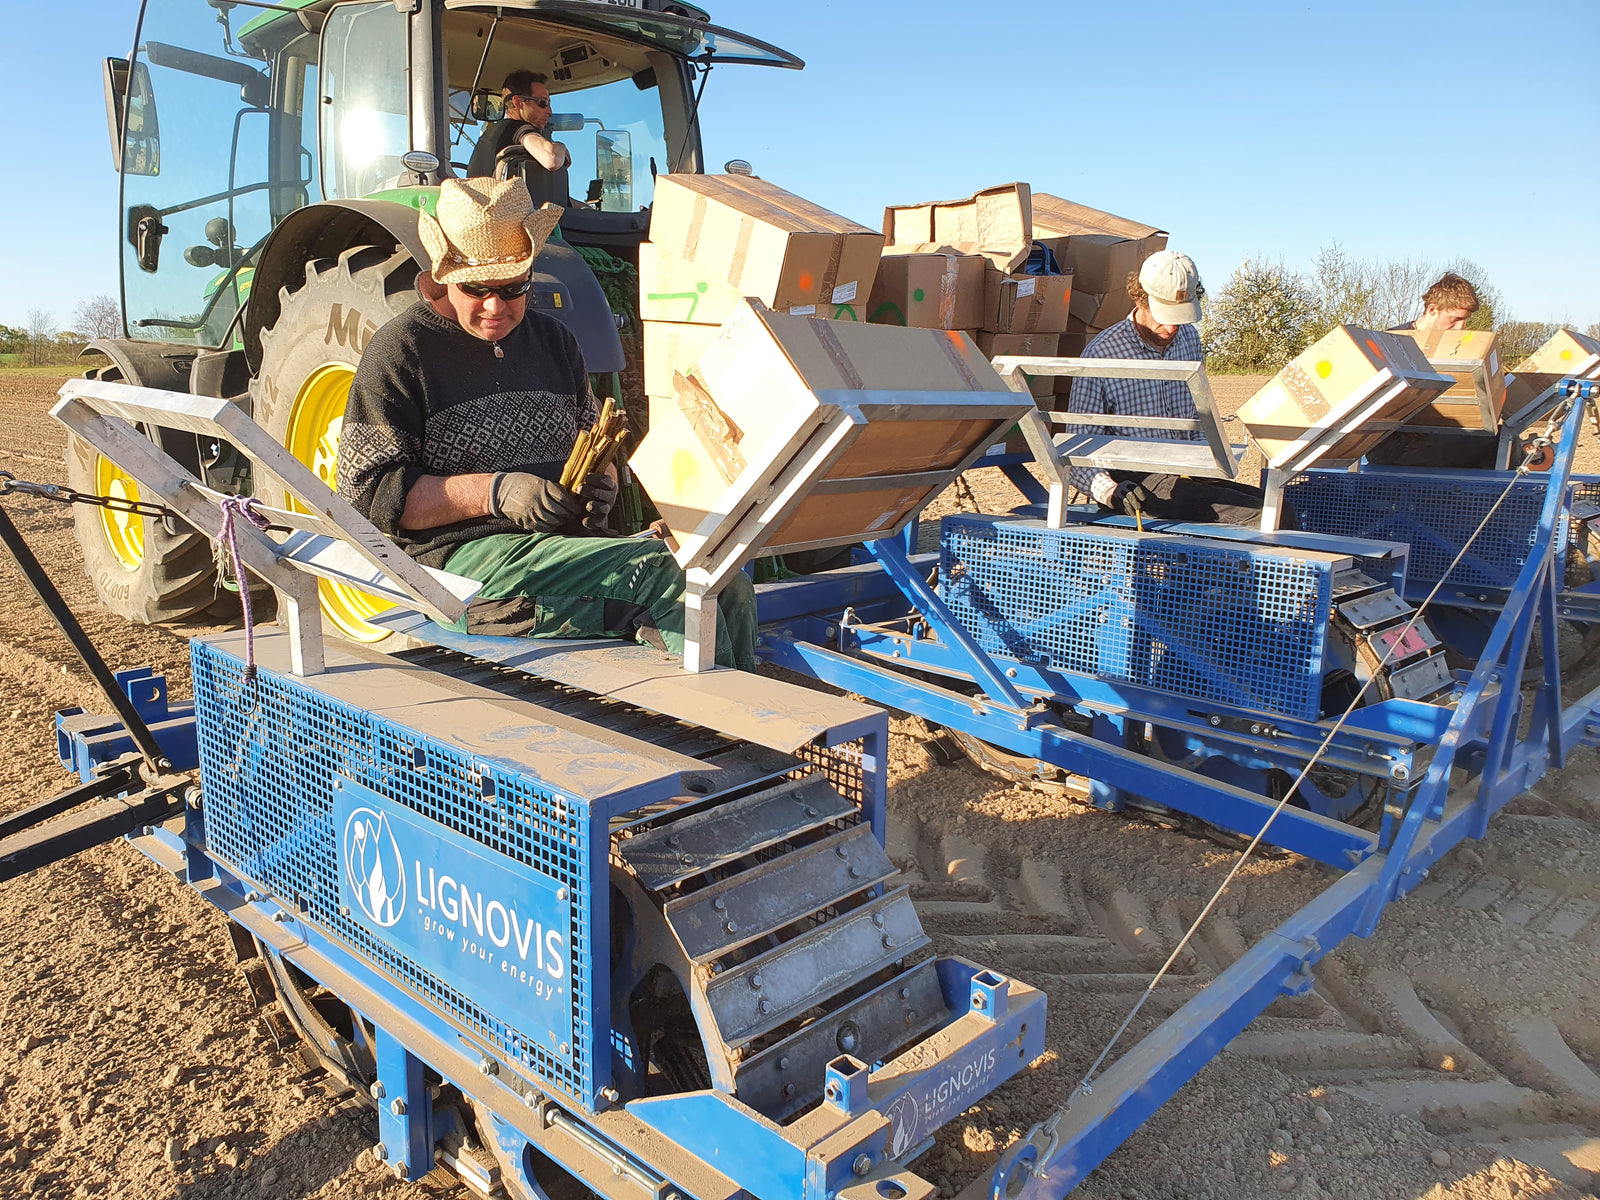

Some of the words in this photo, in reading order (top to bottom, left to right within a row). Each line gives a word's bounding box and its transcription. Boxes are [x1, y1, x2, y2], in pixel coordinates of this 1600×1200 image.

[415, 860, 564, 979] LIGNOVIS
[461, 937, 493, 964] your
[925, 1048, 995, 1113] LIGNOVIS
